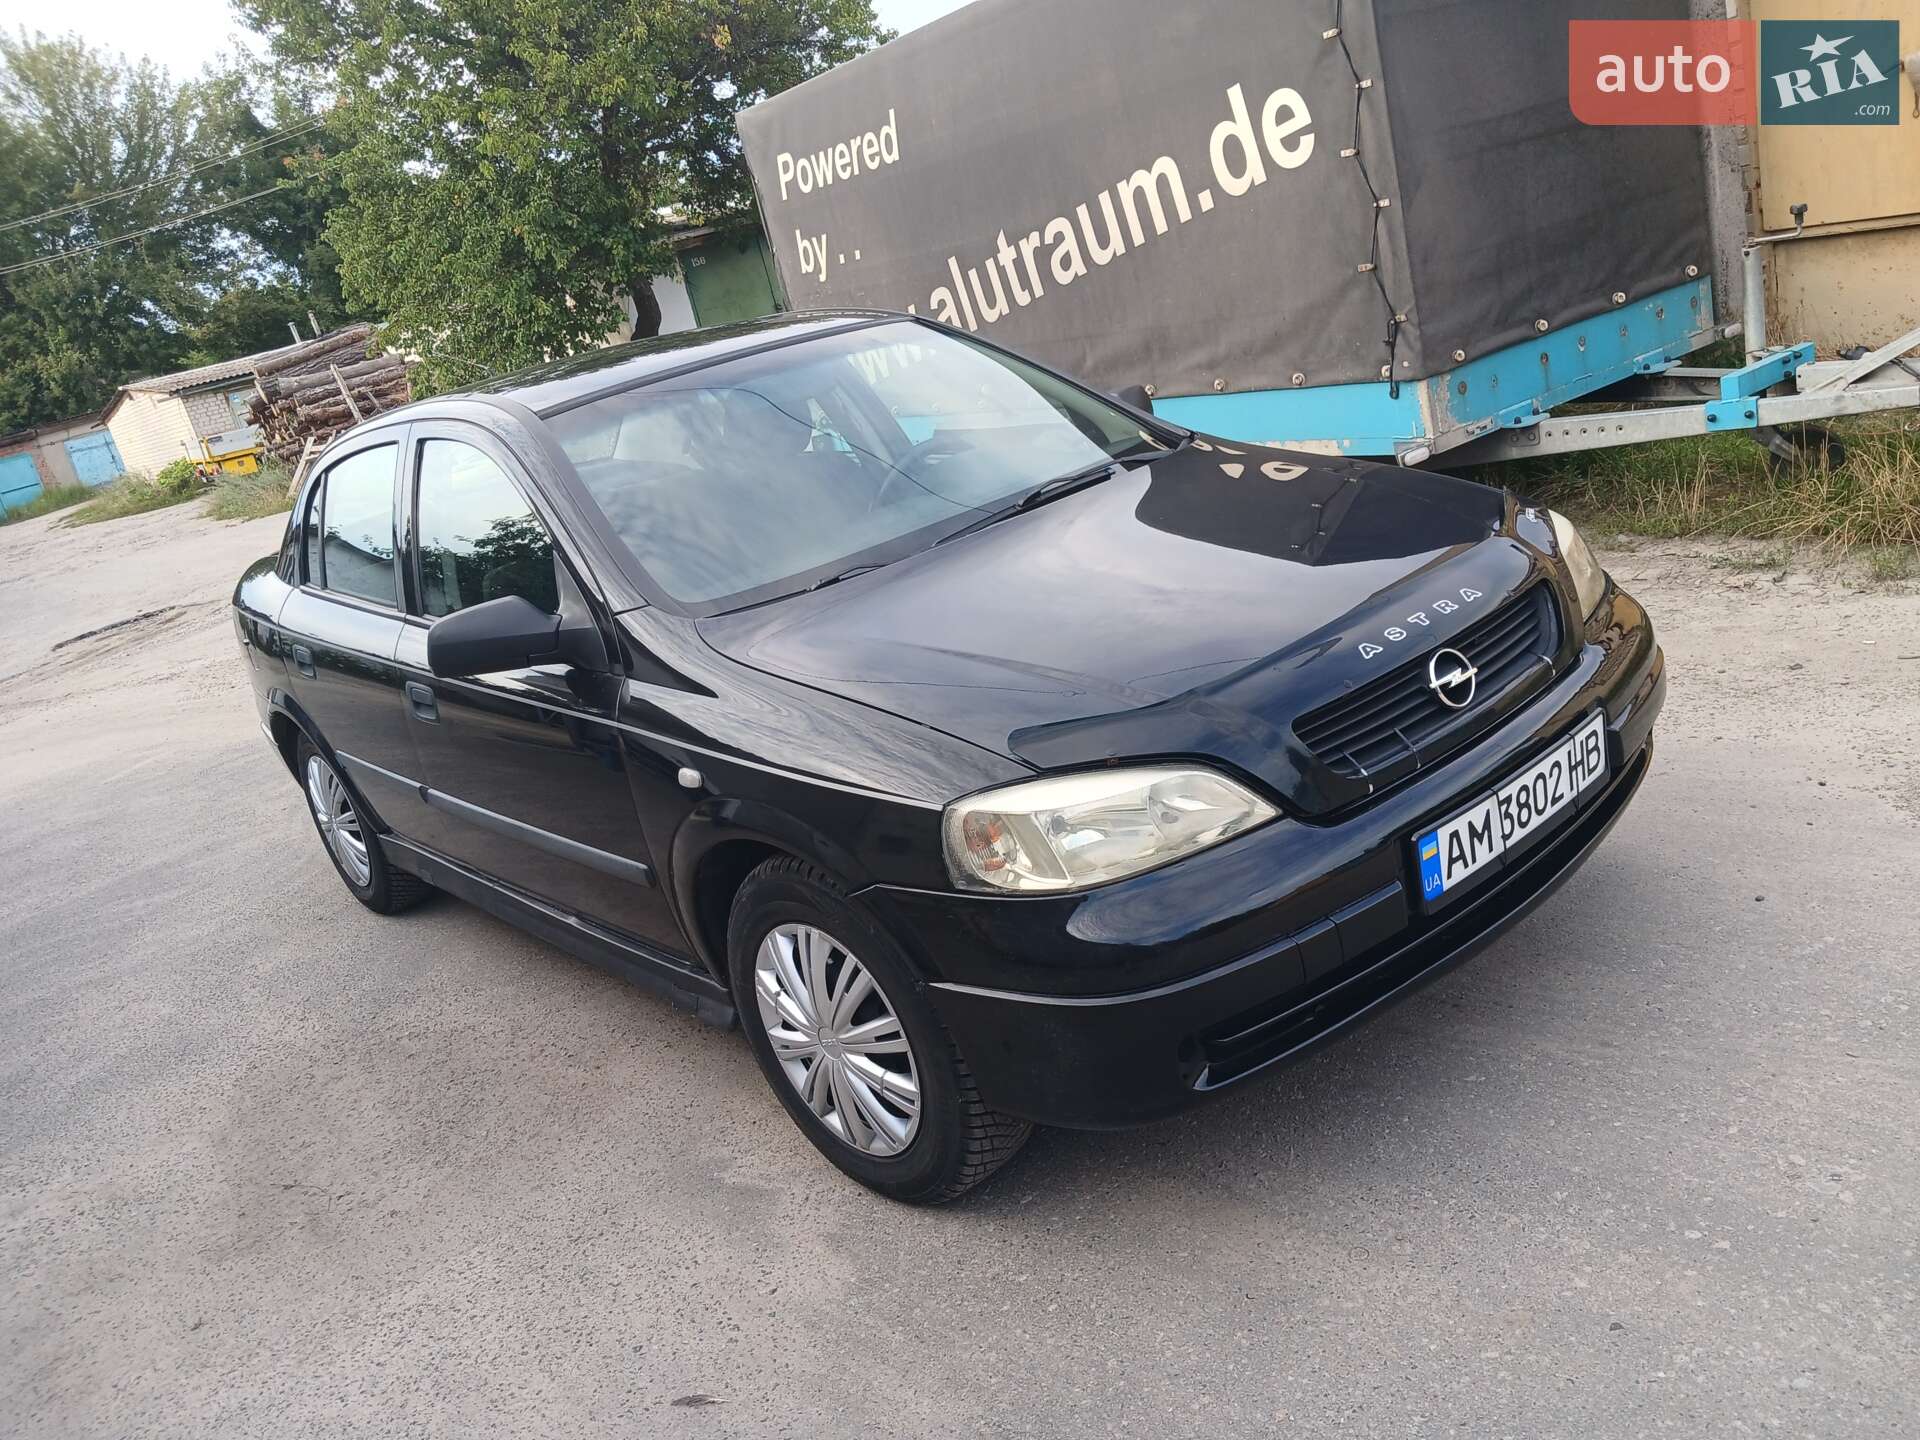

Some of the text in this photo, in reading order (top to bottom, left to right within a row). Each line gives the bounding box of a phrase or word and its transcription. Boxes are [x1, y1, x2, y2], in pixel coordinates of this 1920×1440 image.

[776, 108, 900, 200] Powered
[1358, 587, 1482, 659] ASTRA
[1446, 808, 1494, 881] AM
[1498, 760, 1565, 841] 3802
[1425, 877, 1441, 892] UA
